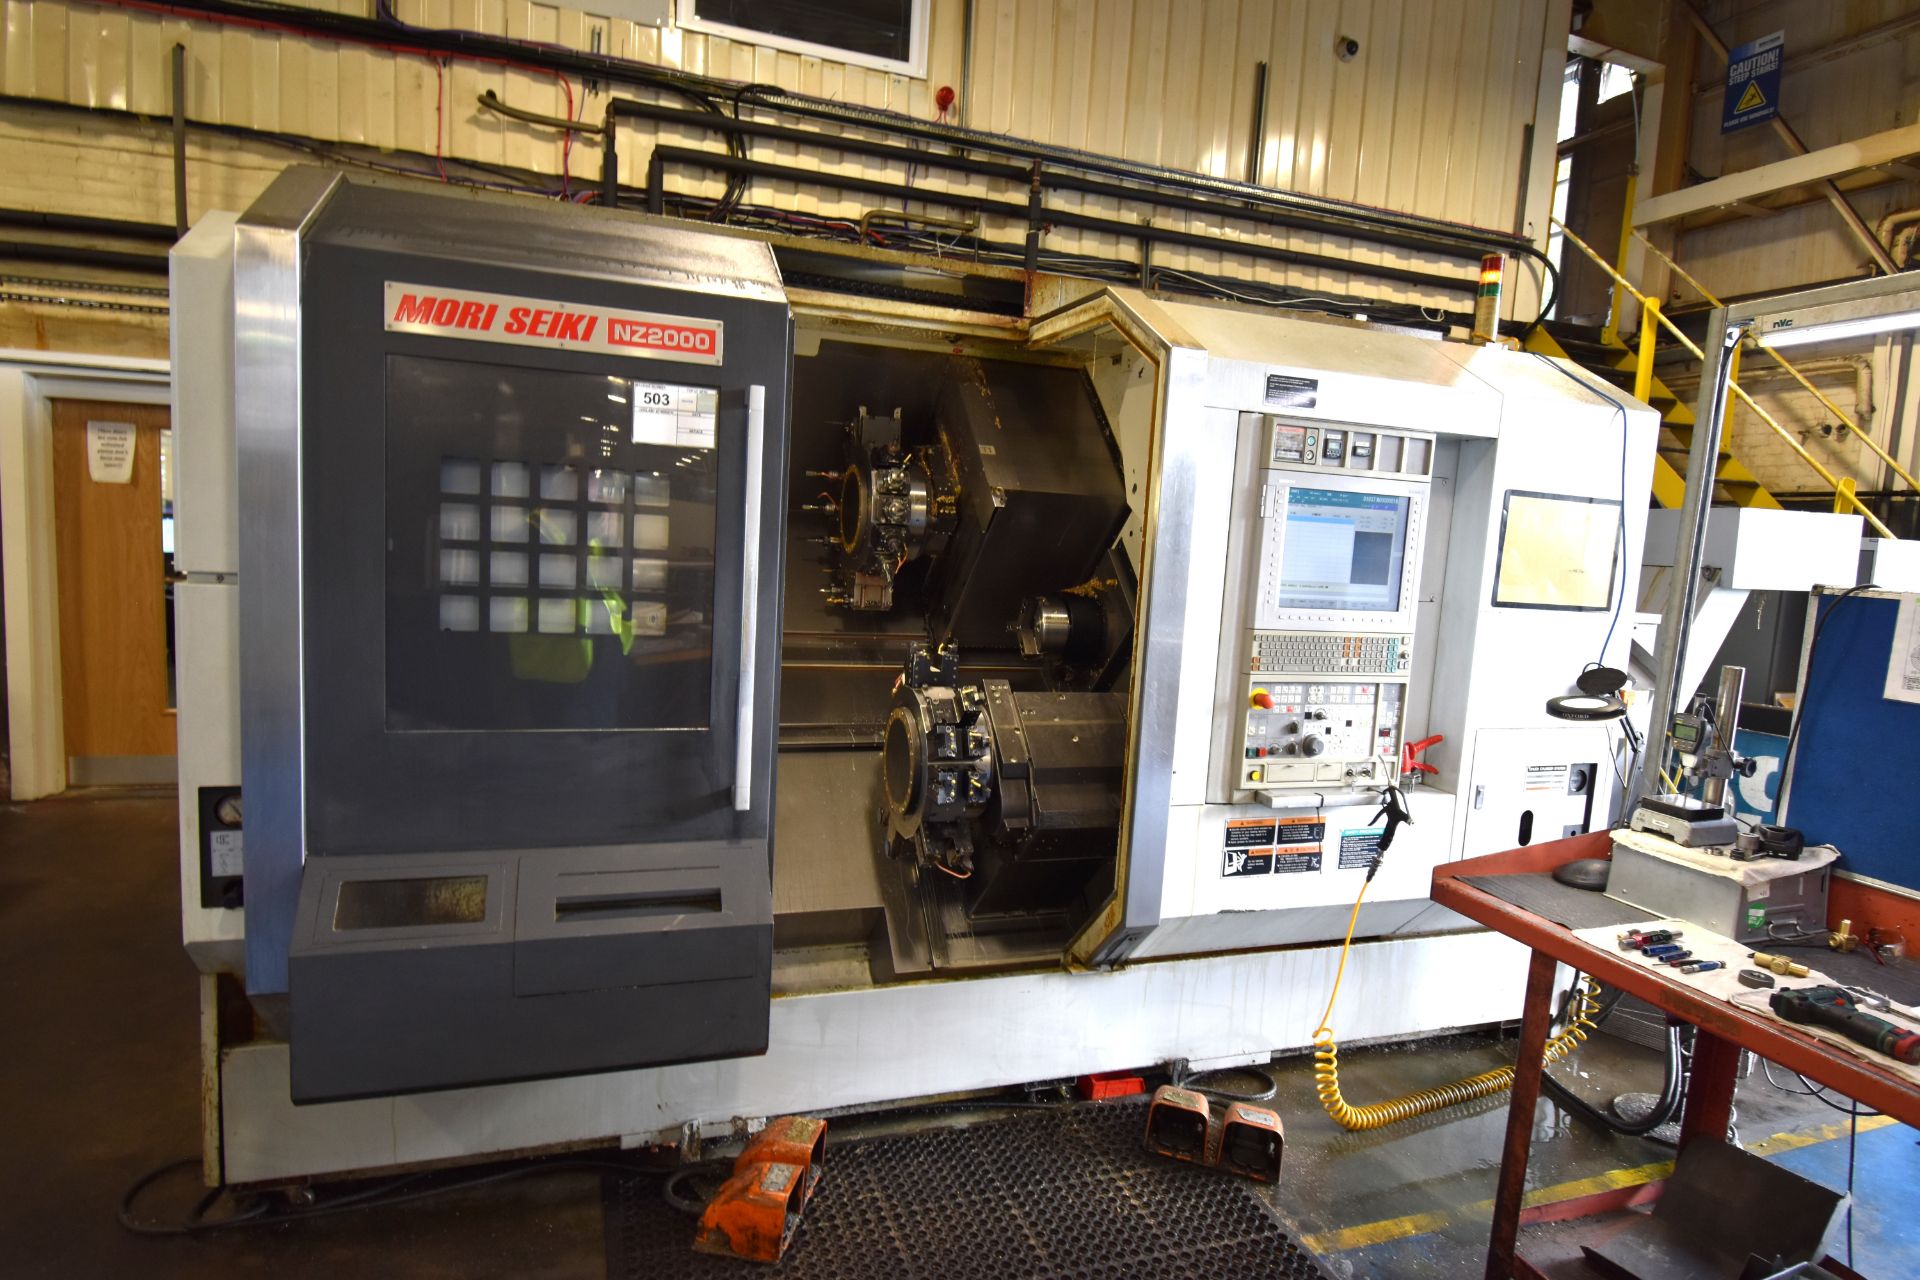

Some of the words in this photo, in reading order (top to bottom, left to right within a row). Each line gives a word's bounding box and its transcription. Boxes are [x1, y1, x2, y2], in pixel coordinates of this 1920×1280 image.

[1730, 48, 1779, 77] CAUTION!
[1728, 72, 1750, 86] STEEP
[394, 294, 498, 331] MORI
[504, 307, 599, 342] SEIKI
[613, 324, 710, 350] NZ2000
[644, 392, 670, 406] 503
